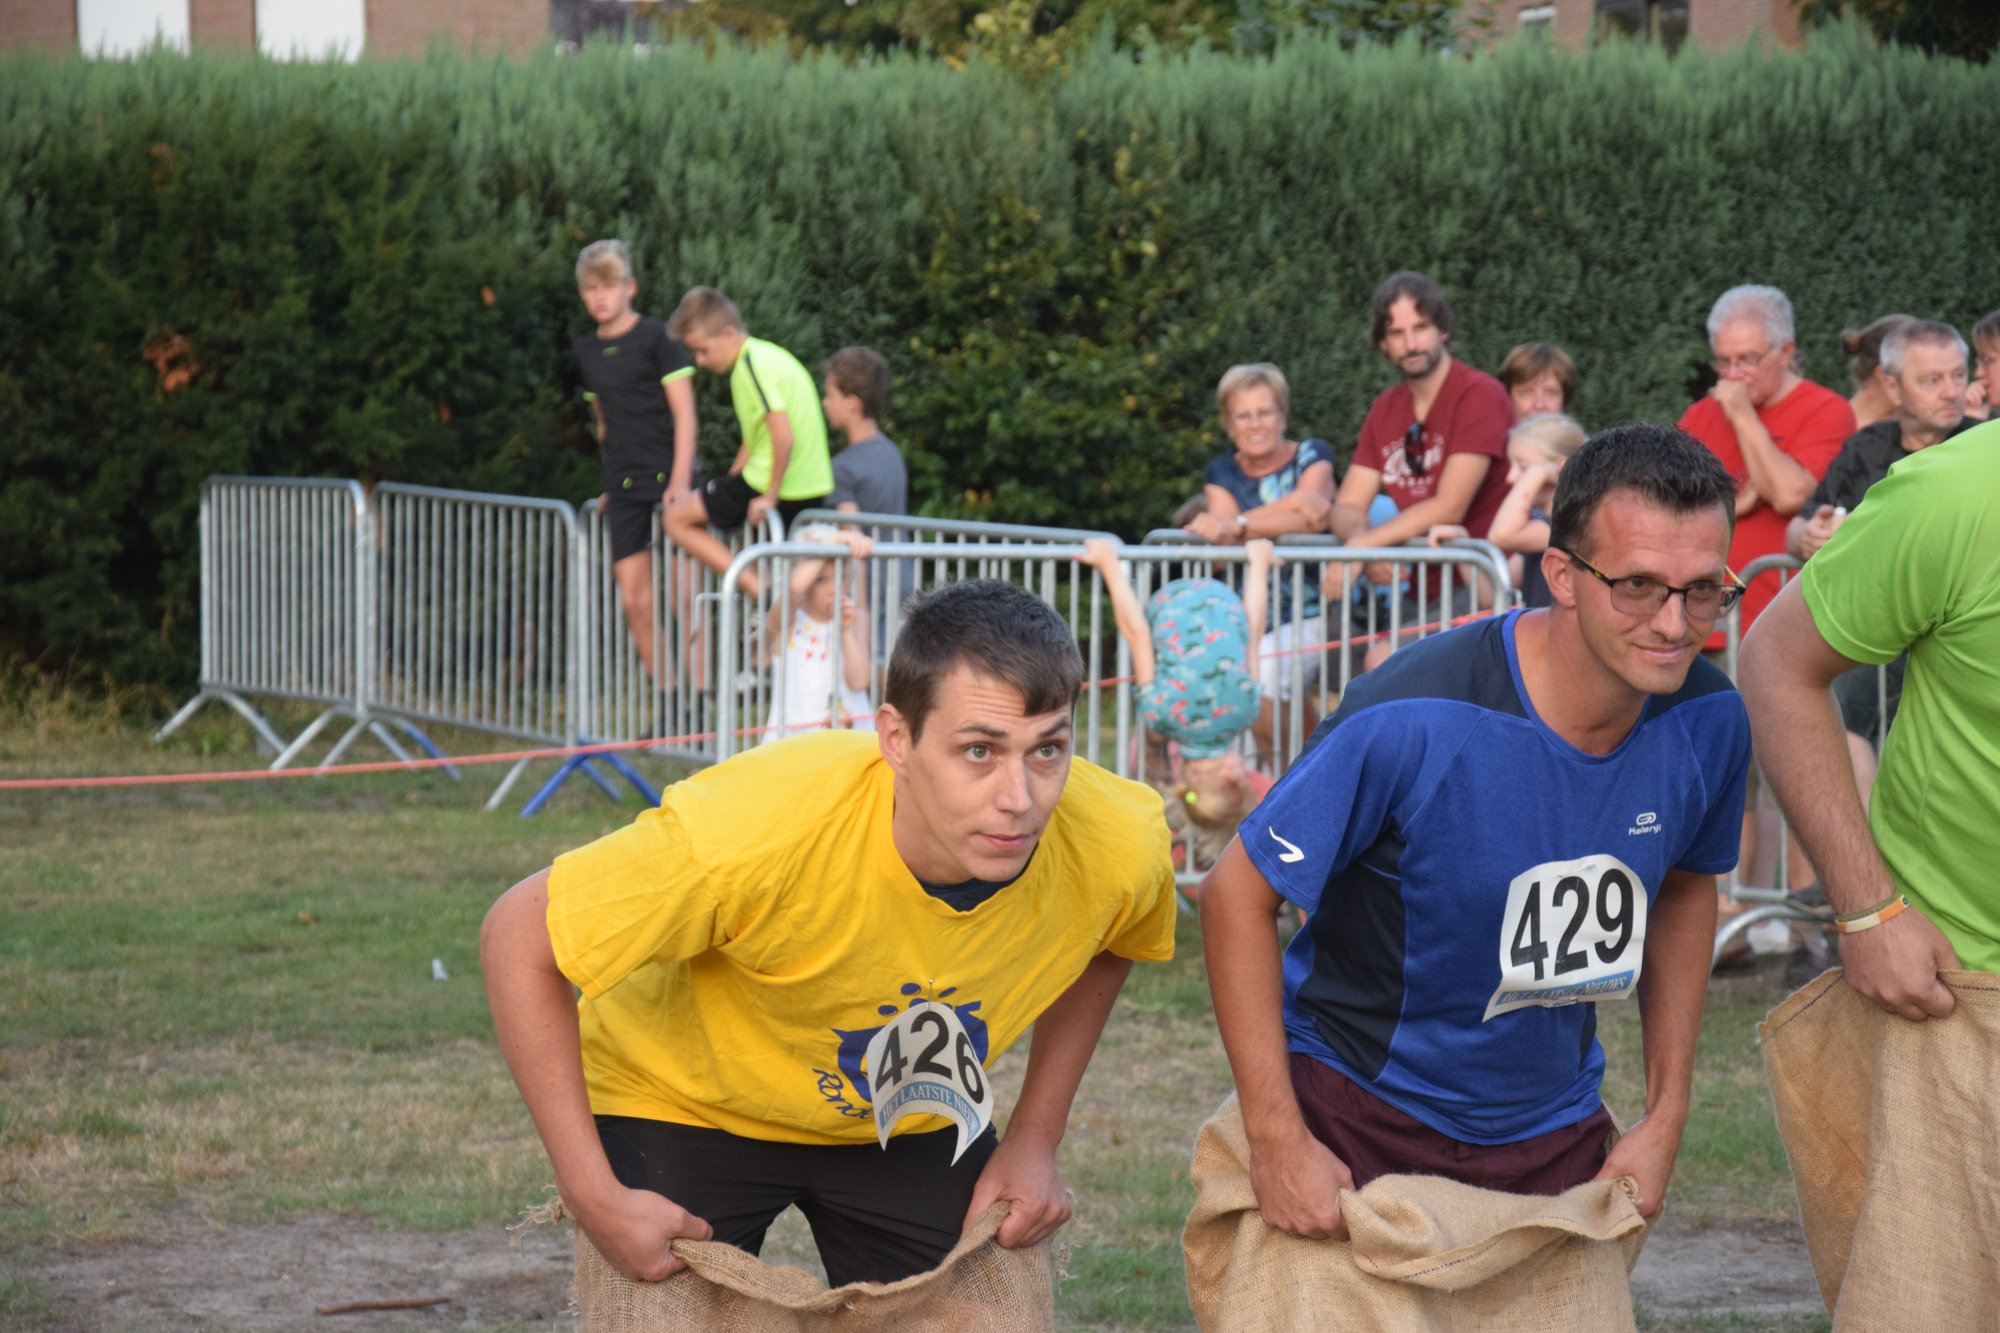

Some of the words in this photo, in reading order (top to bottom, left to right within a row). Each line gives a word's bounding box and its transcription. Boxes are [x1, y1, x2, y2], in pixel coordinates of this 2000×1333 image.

[1628, 823, 1662, 836] Kalenji
[1510, 868, 1634, 982] 429
[875, 1010, 985, 1105] 426
[882, 1094, 900, 1121] HET
[901, 1084, 953, 1105] LAATSTE
